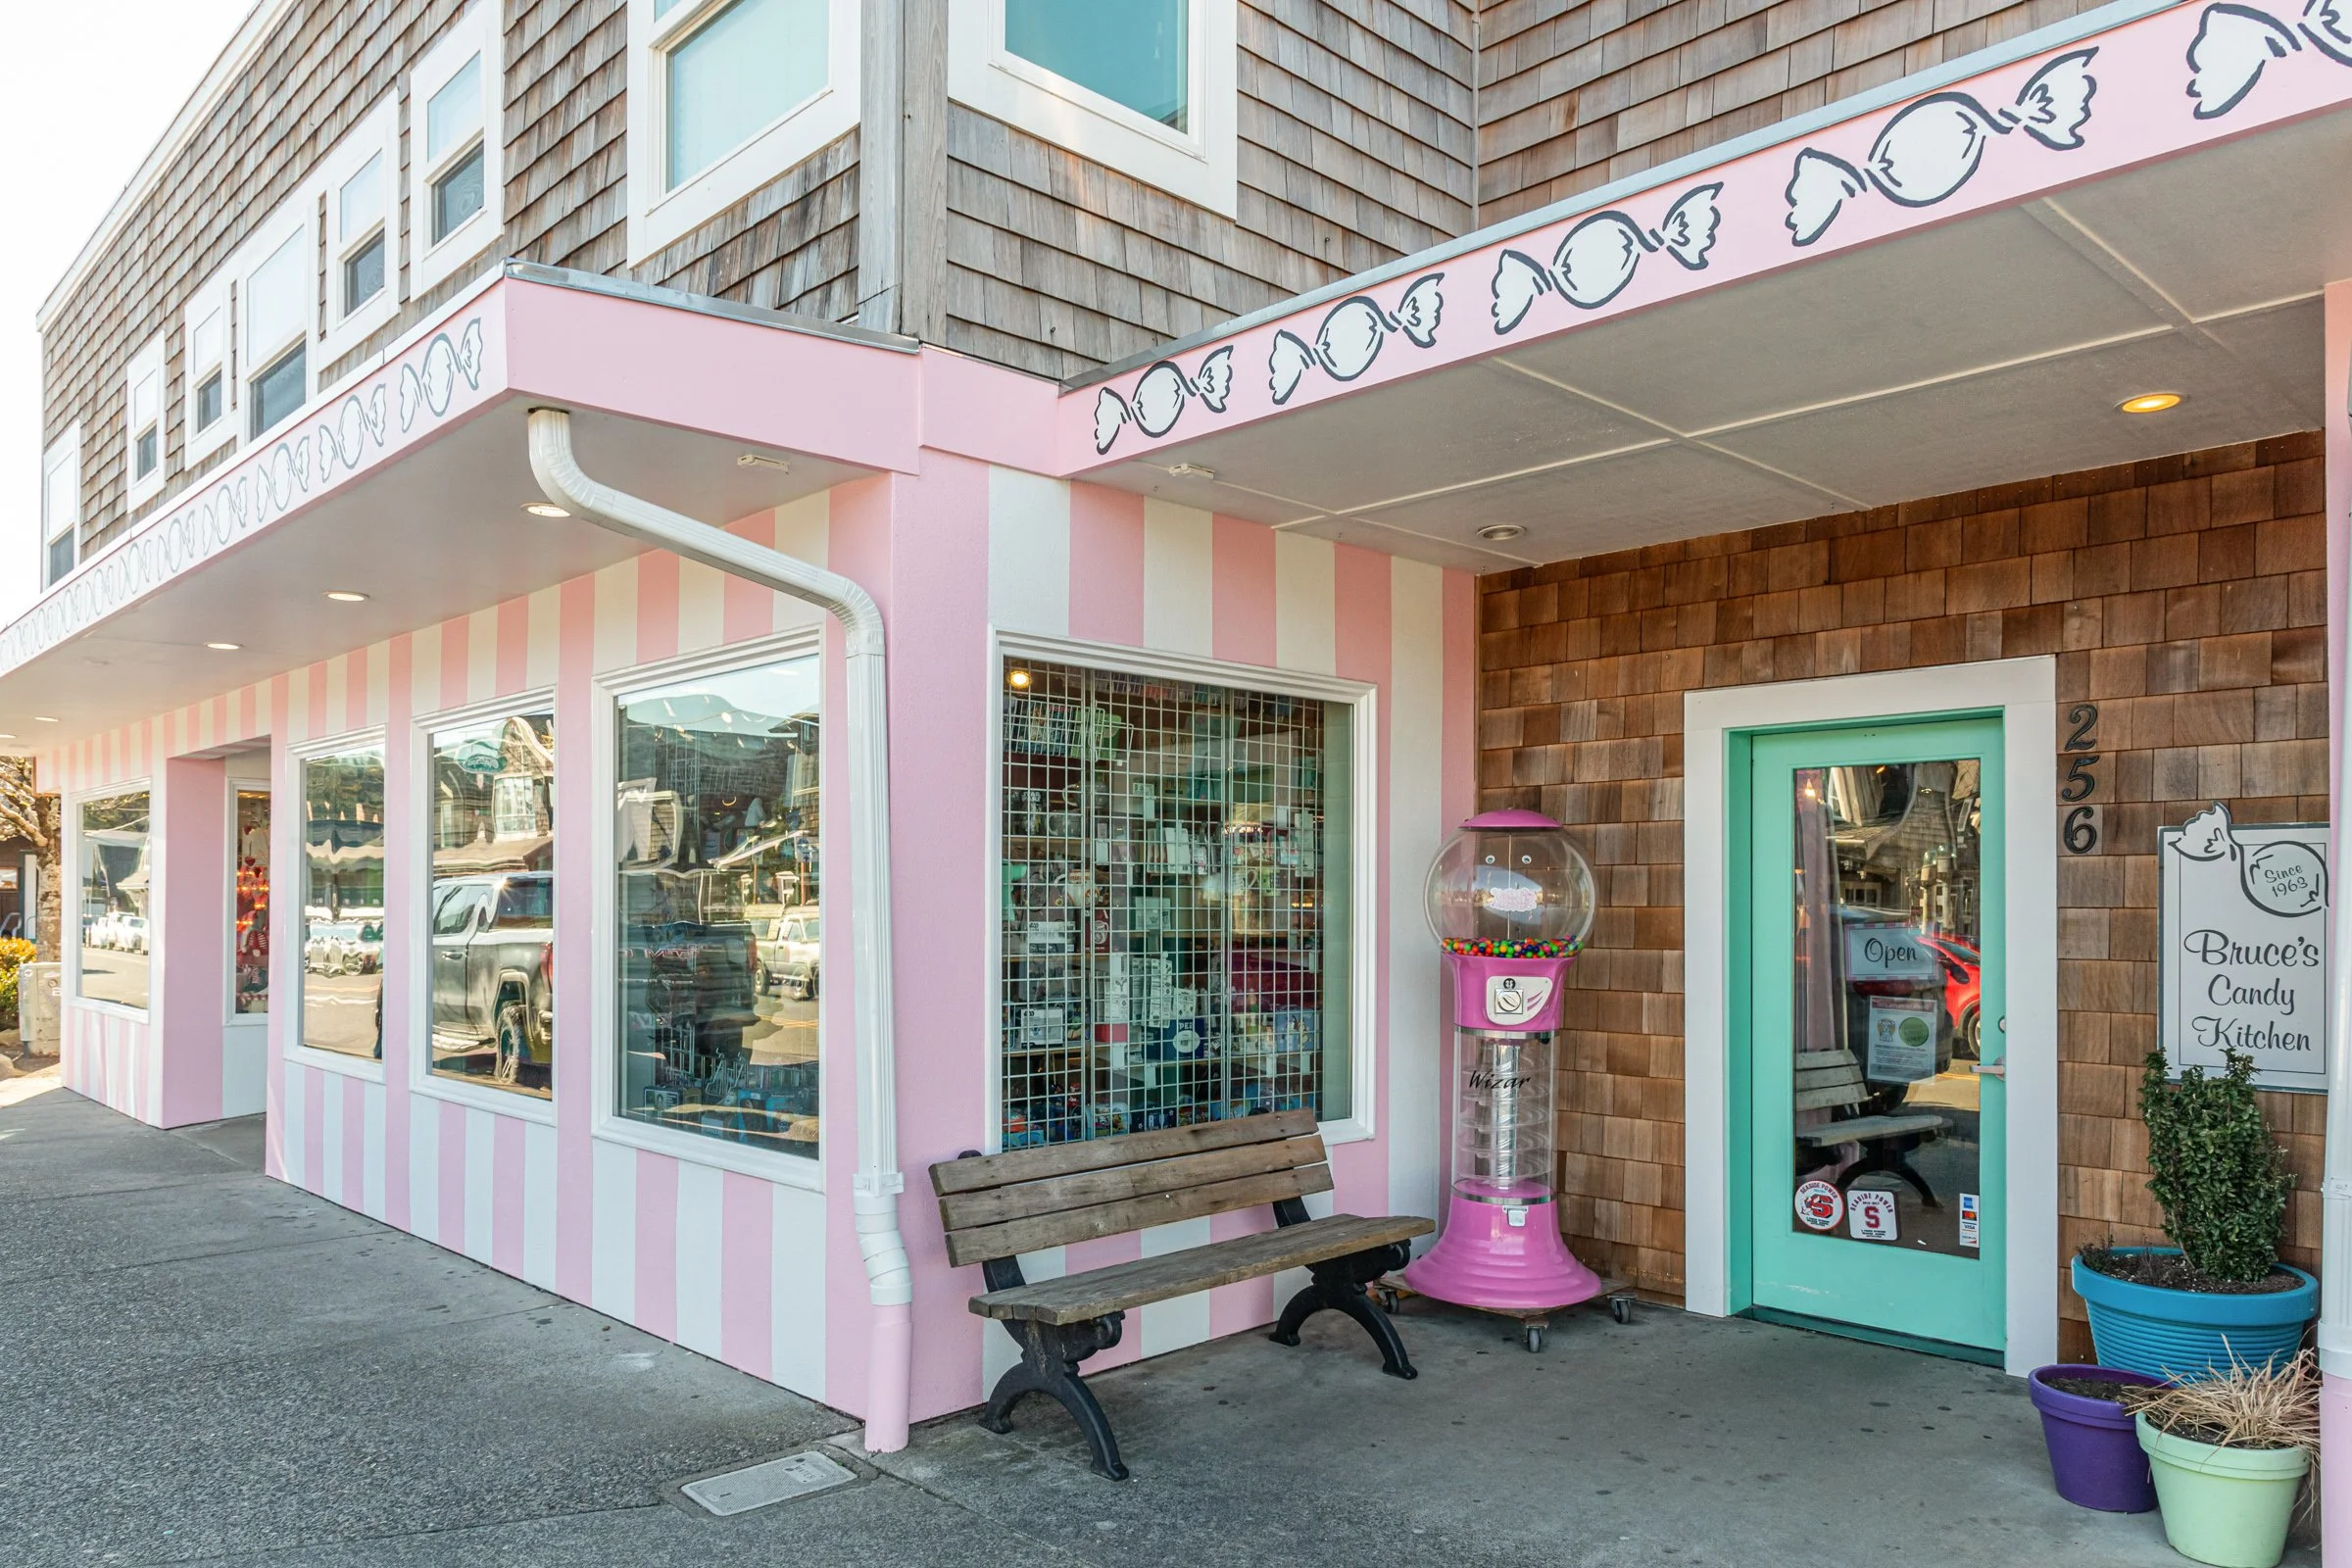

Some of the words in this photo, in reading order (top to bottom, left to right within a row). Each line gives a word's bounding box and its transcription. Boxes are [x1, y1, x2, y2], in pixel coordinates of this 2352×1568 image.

[2062, 704, 2099, 855] 256
[2264, 864, 2303, 884] Since
[2272, 876, 2309, 898] 1963
[1864, 937, 1917, 968] Open
[2183, 929, 2319, 967] Bruce's
[2208, 973, 2294, 1015] Candy
[2191, 1015, 2311, 1051] Kitchen
[1799, 1182, 1820, 1195] SEASIDE
[1821, 1183, 1838, 1199] POWER
[1850, 1193, 1872, 1211] SEASIDE
[1875, 1194, 1893, 1213] POWER
[1864, 1205, 1881, 1229] S
